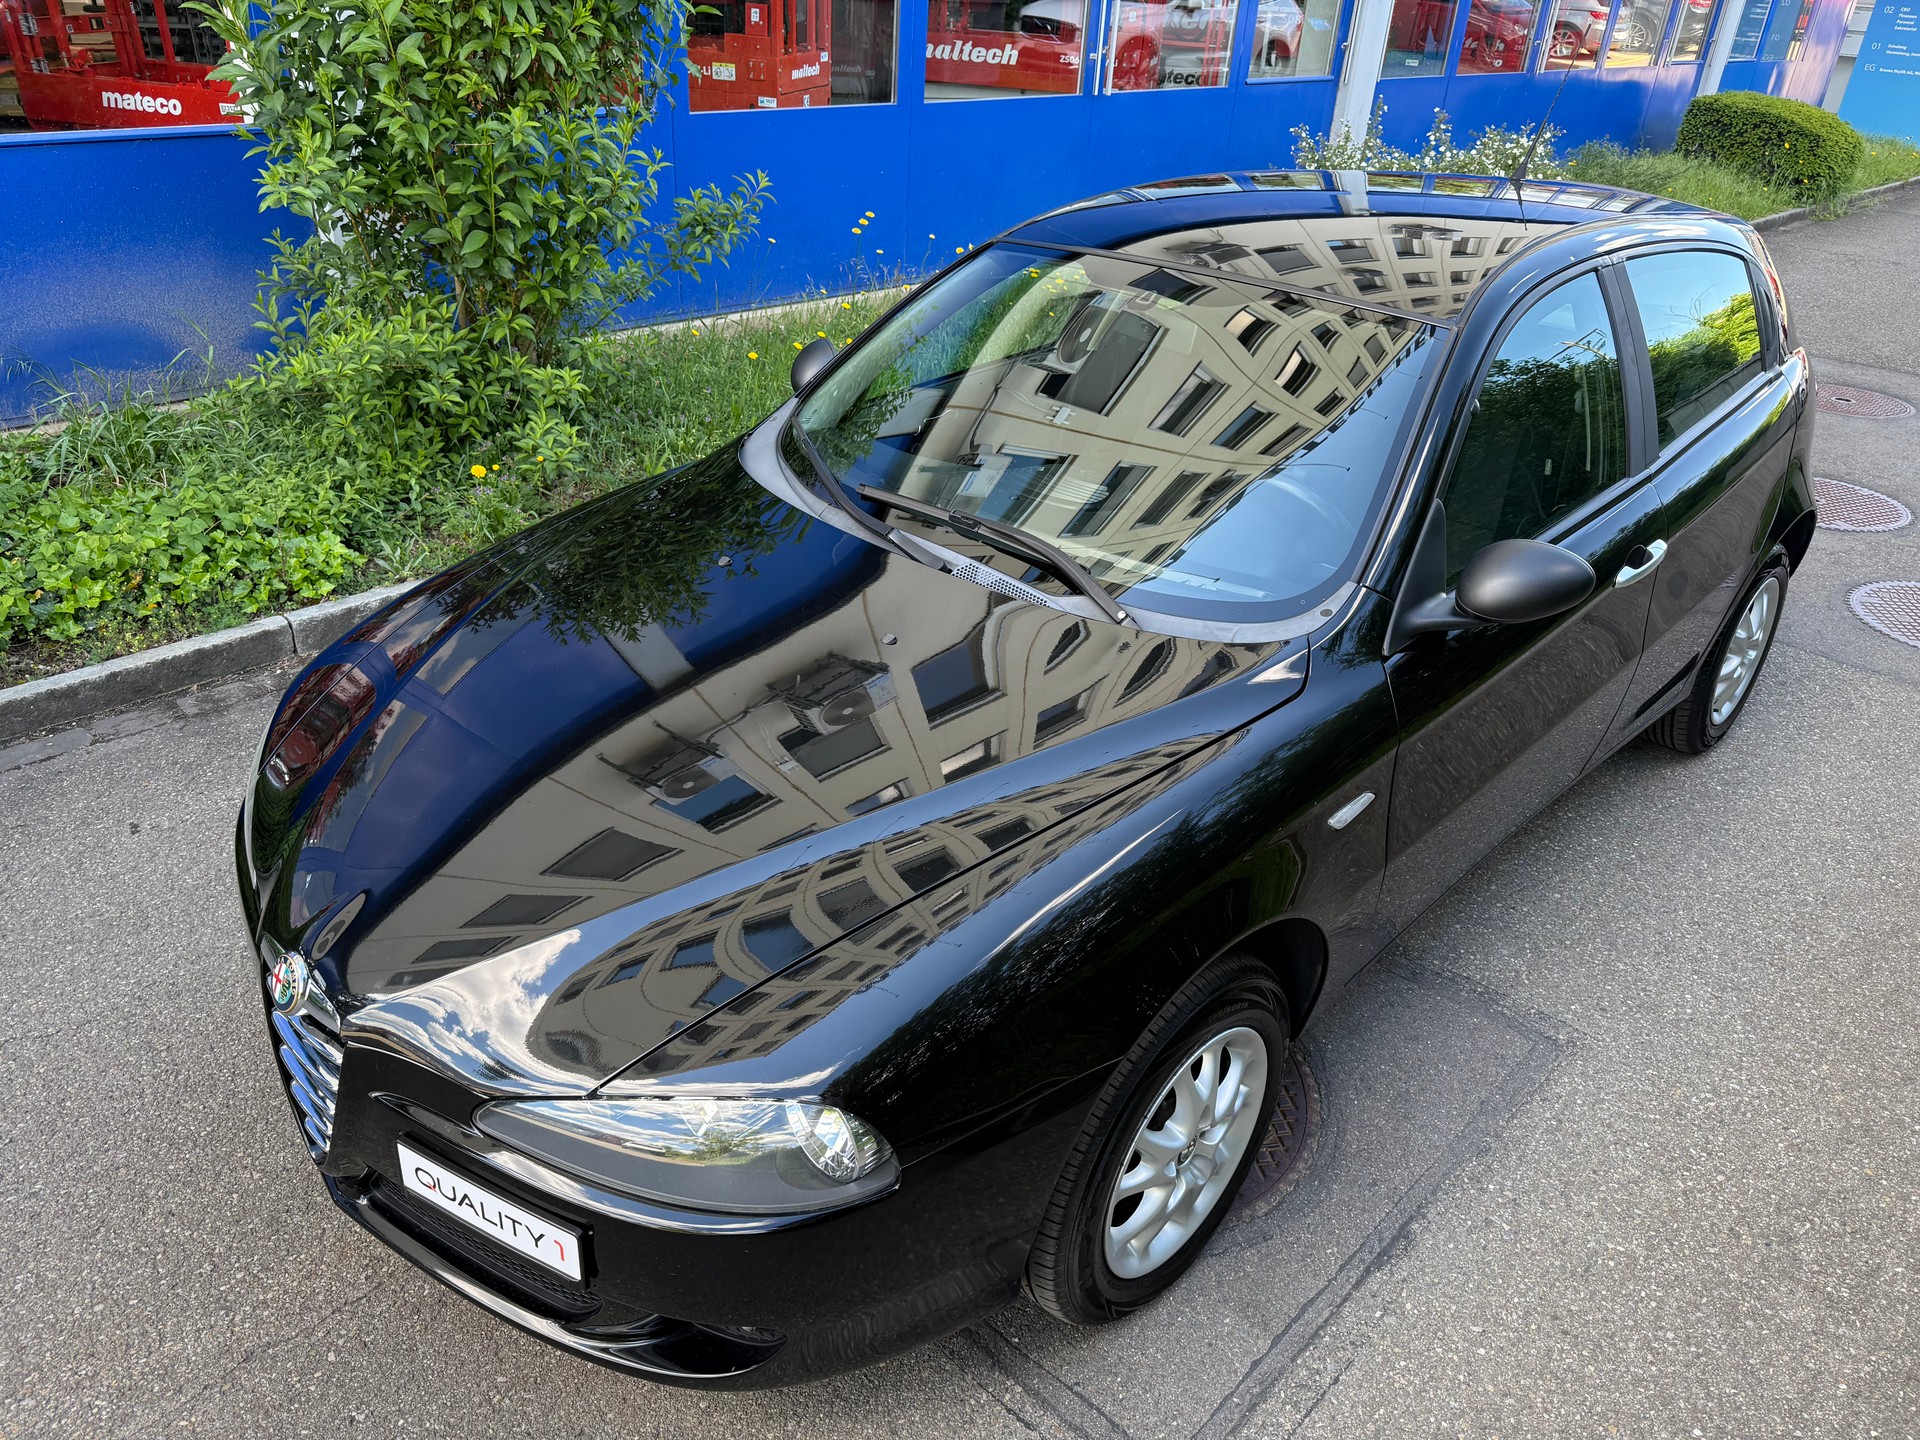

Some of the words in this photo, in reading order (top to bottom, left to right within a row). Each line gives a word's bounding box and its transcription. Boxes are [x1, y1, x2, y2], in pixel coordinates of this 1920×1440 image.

[1884, 5, 1895, 14] 02
[1871, 42, 1881, 50] 01
[791, 62, 820, 80] maltech
[1864, 63, 1876, 72] EG
[101, 91, 183, 116] mateco
[414, 1166, 546, 1248] QUALITY
[553, 1239, 565, 1262] 1
